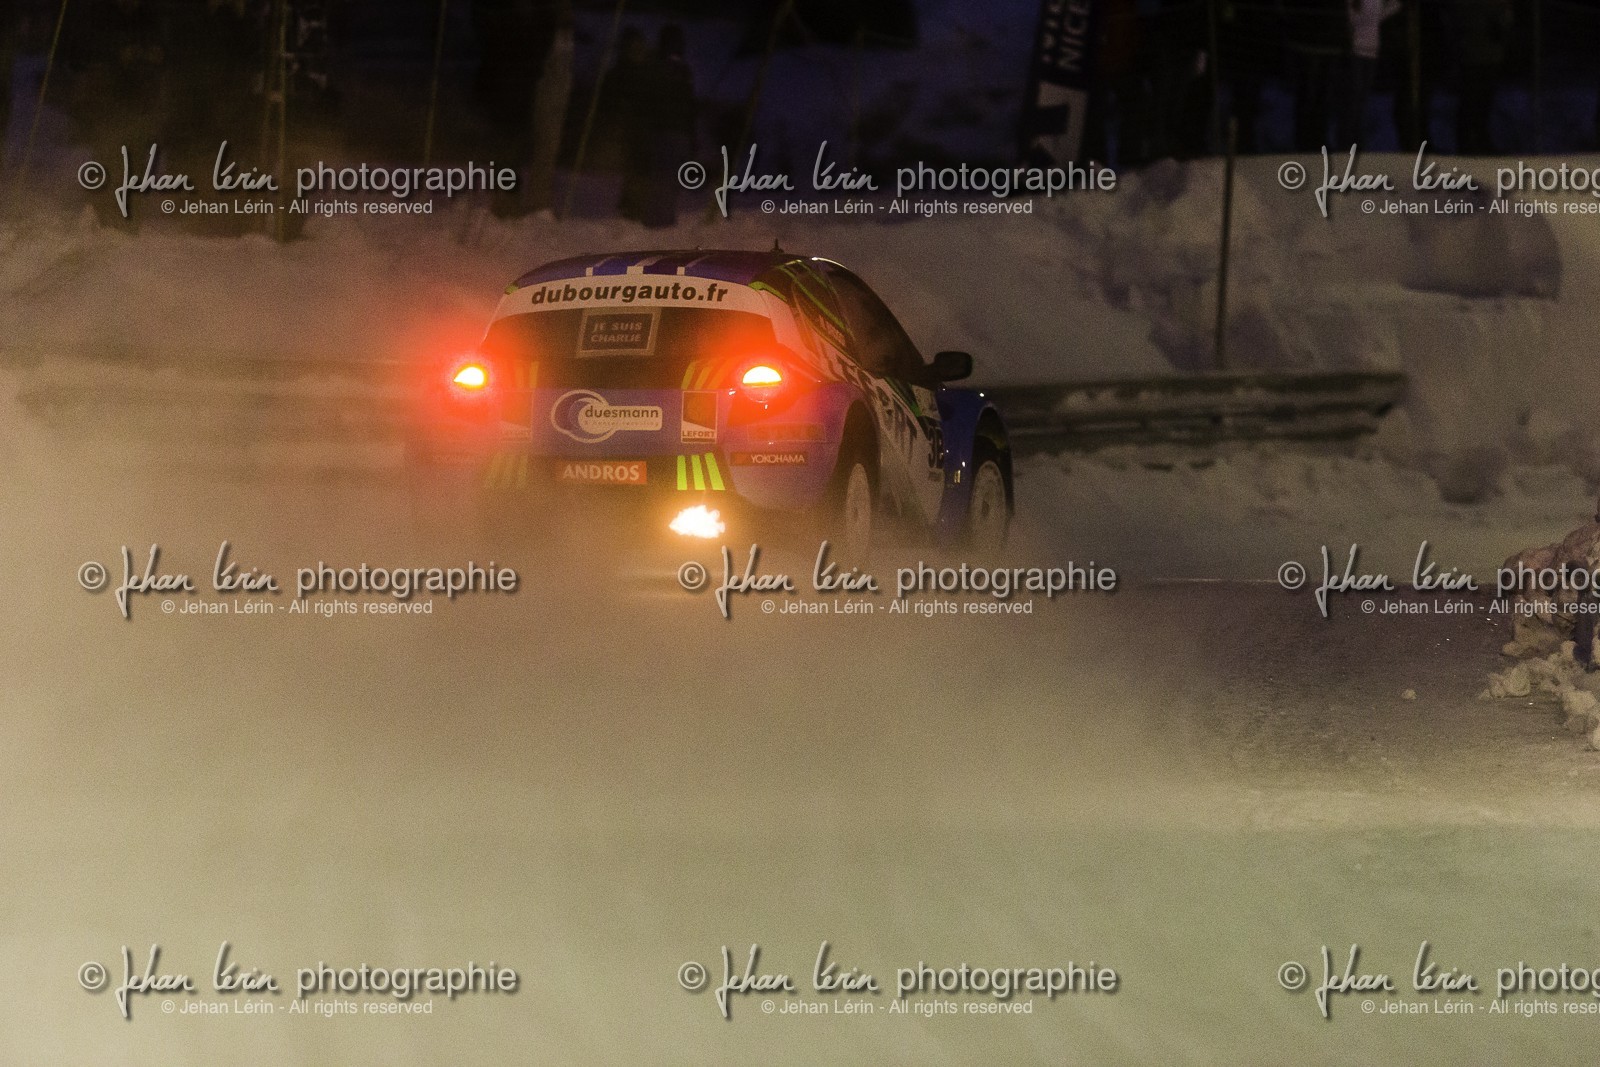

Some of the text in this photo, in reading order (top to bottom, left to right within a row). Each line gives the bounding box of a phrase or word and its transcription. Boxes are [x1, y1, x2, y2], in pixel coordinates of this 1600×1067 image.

[532, 281, 728, 305] dubourgauto.fr
[591, 321, 643, 333] JE SUIS
[590, 333, 642, 343] CHARLIE
[584, 405, 659, 418] duesmann
[682, 430, 716, 438] LEFORT
[751, 454, 806, 464] YOKOHAMA
[562, 463, 640, 482] ANDROS
